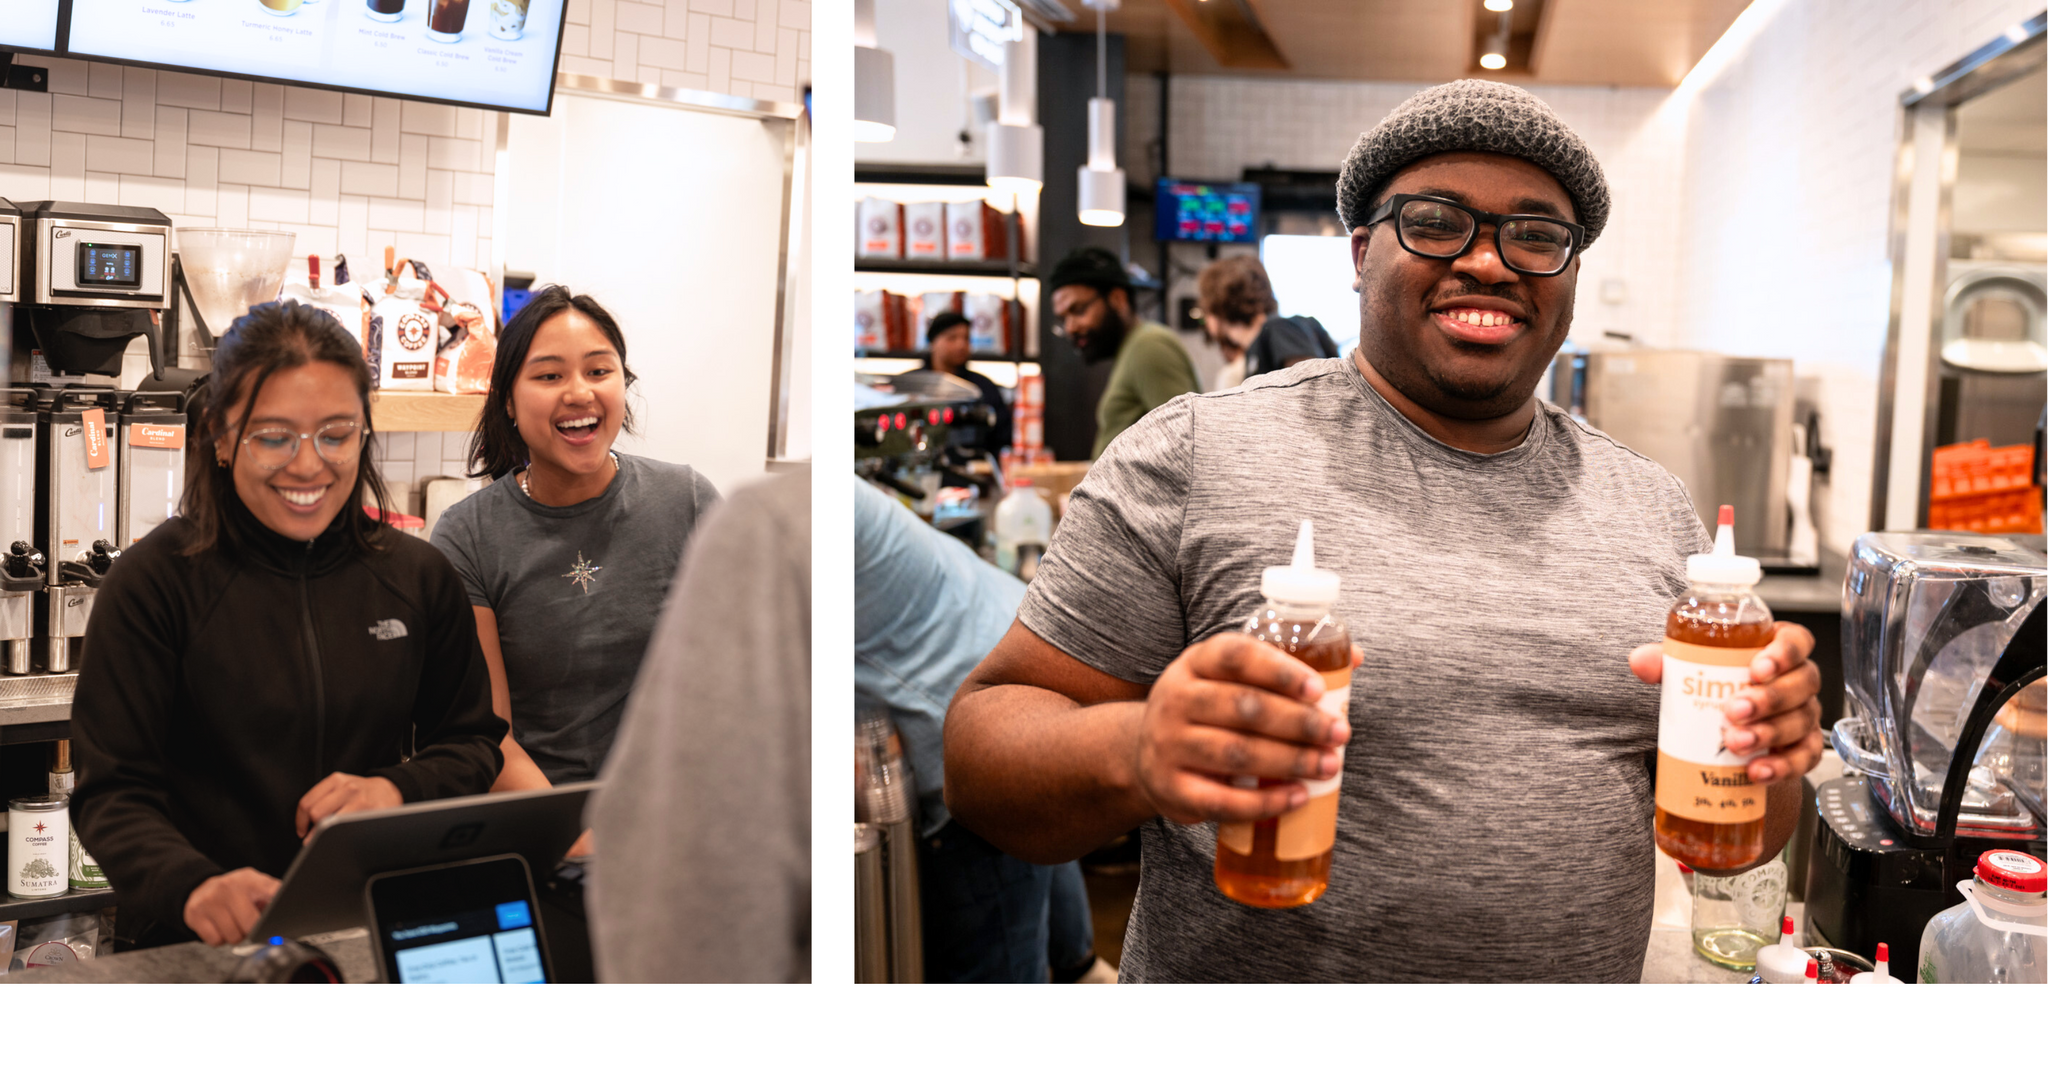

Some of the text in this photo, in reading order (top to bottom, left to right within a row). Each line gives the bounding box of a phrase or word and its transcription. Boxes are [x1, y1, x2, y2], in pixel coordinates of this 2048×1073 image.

[142, 6, 196, 20] Lavender Latte
[160, 20, 175, 28] 6.65
[241, 20, 313, 37] Turmeric Honey Latte
[358, 28, 406, 40] Mint Cold Brew
[416, 47, 470, 61] Classic Cold Brew
[487, 55, 502, 63] Cold
[504, 49, 524, 57] Cream
[141, 427, 175, 438] Cardinal
[88, 421, 99, 457] Cardinal
